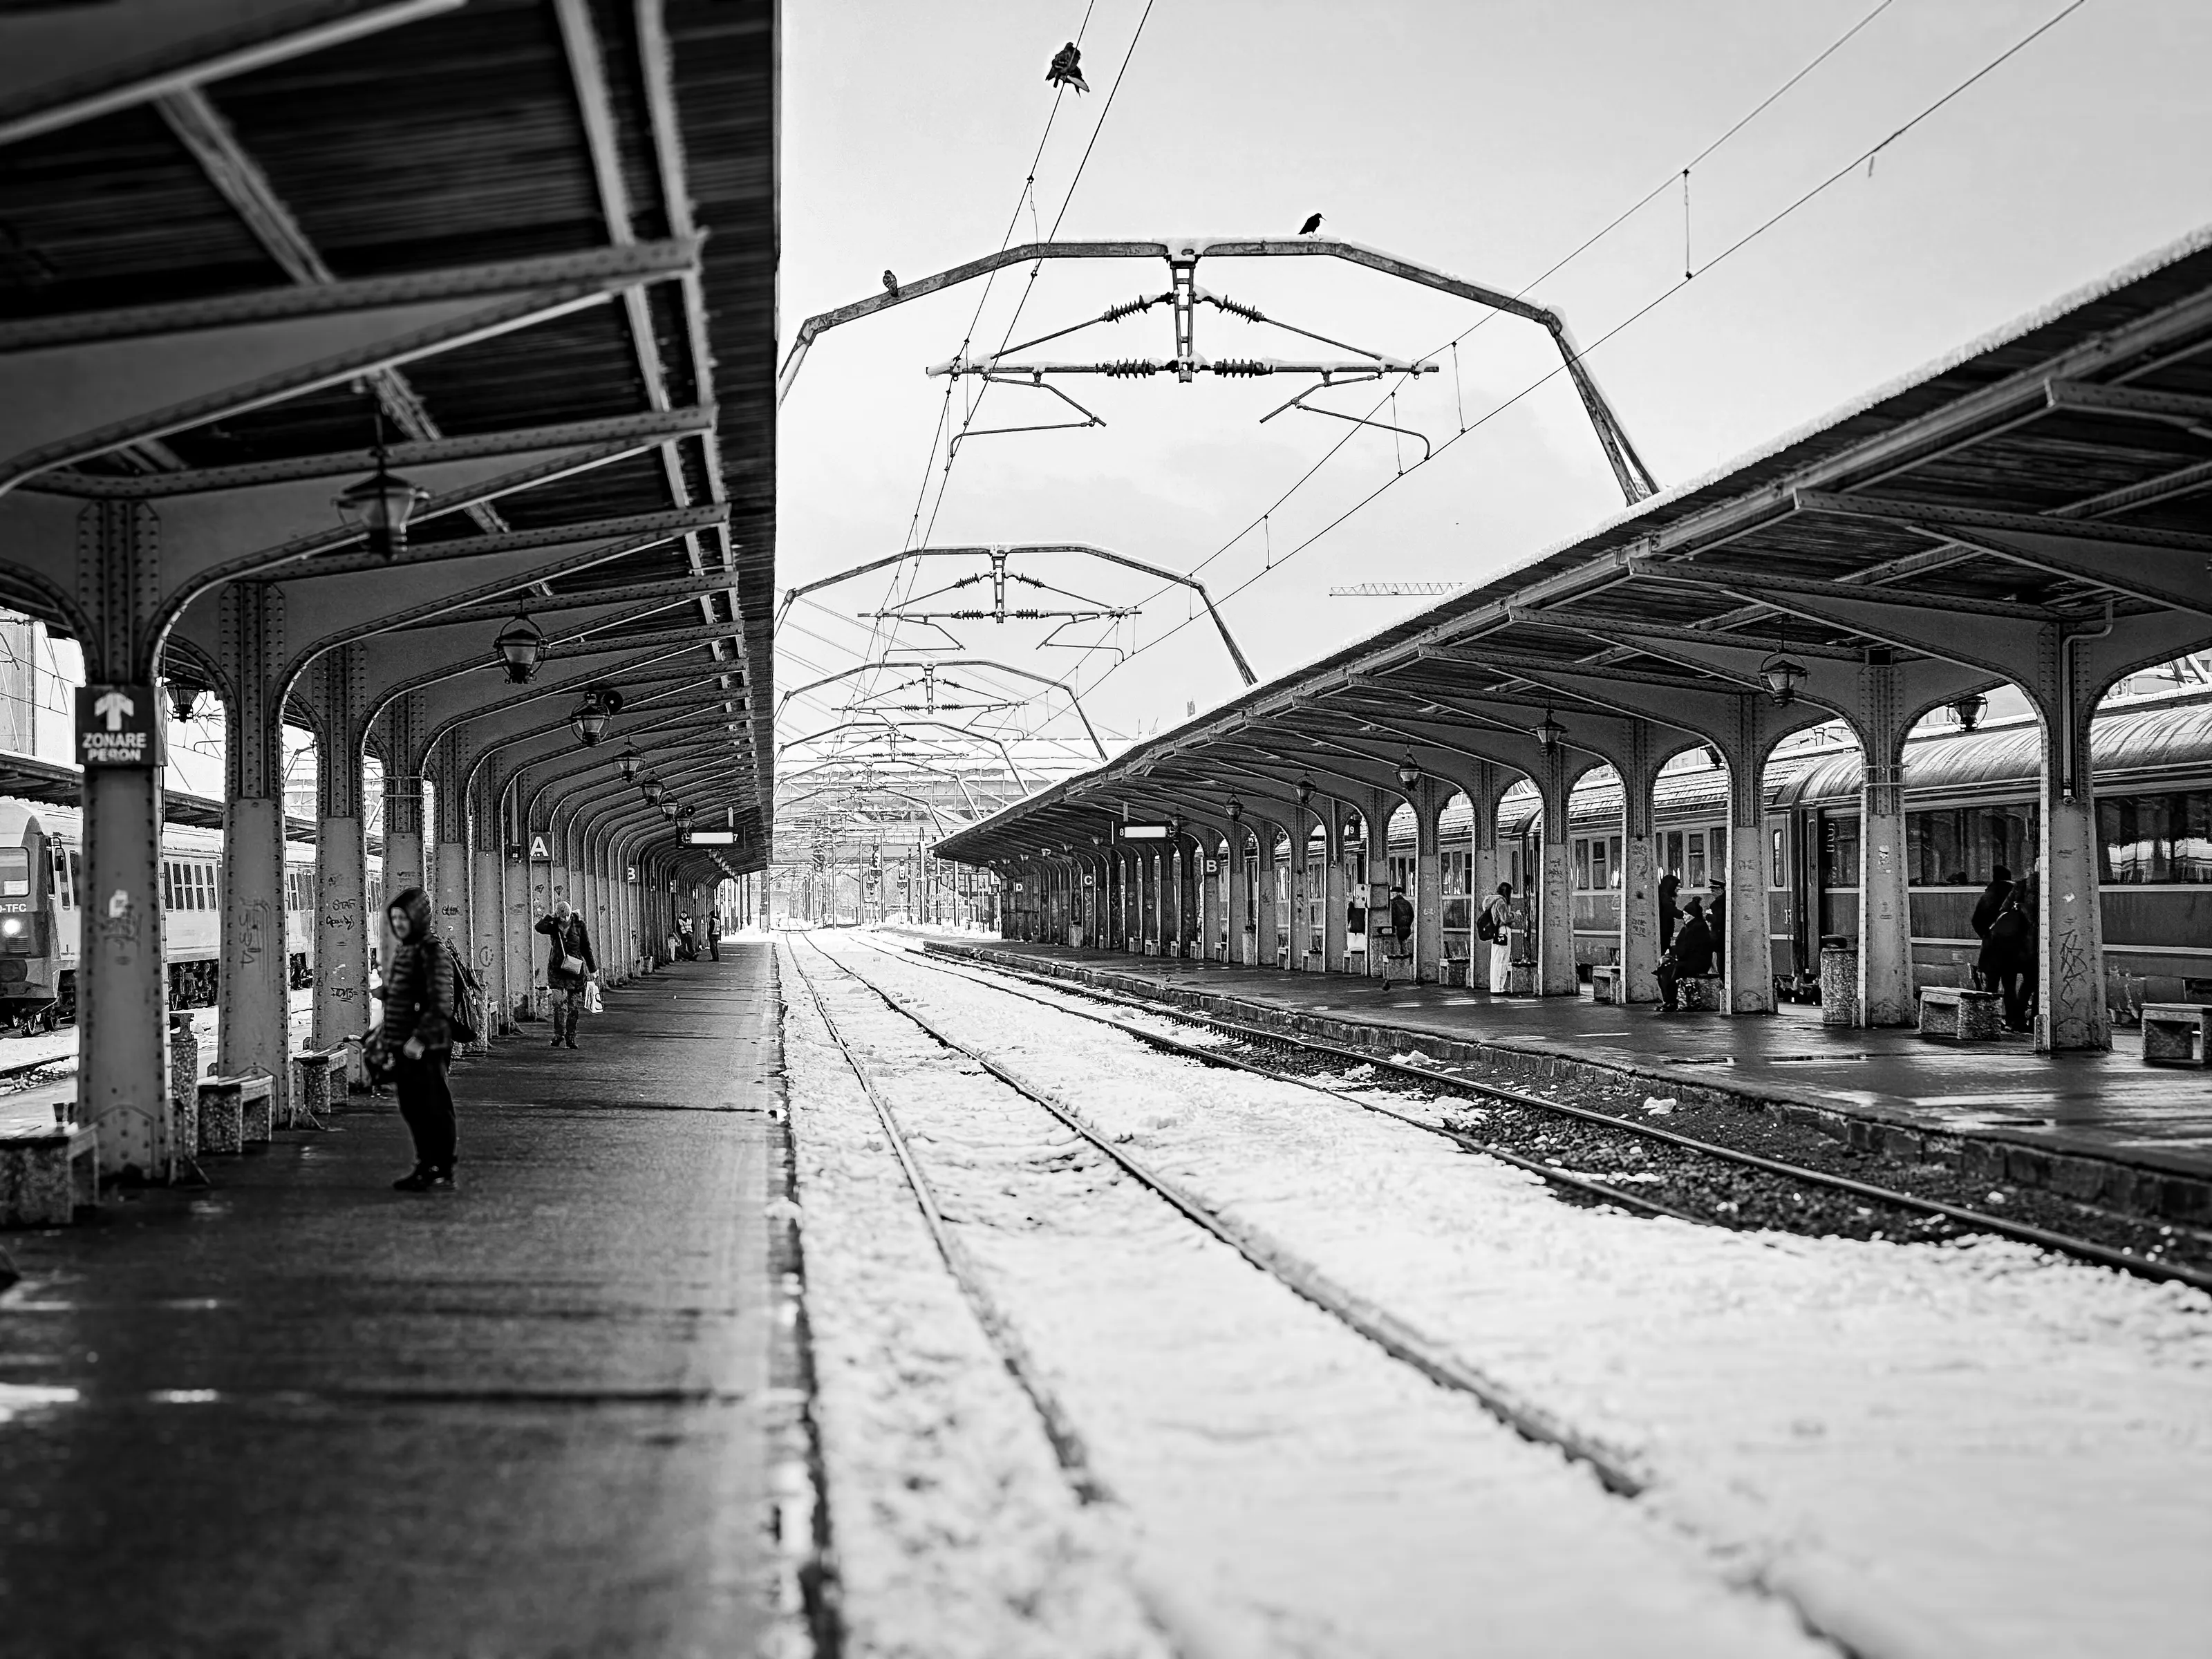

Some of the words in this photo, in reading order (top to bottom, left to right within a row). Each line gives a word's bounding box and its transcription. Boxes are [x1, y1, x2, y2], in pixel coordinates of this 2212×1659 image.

[82, 733, 147, 748] ZONARE
[88, 748, 141, 762] PERON
[1119, 828, 1124, 836] 8
[733, 834, 738, 842] 7
[530, 836, 549, 856] A
[1206, 860, 1217, 872] B
[1084, 875, 1092, 885] C
[1015, 883, 1023, 892] D
